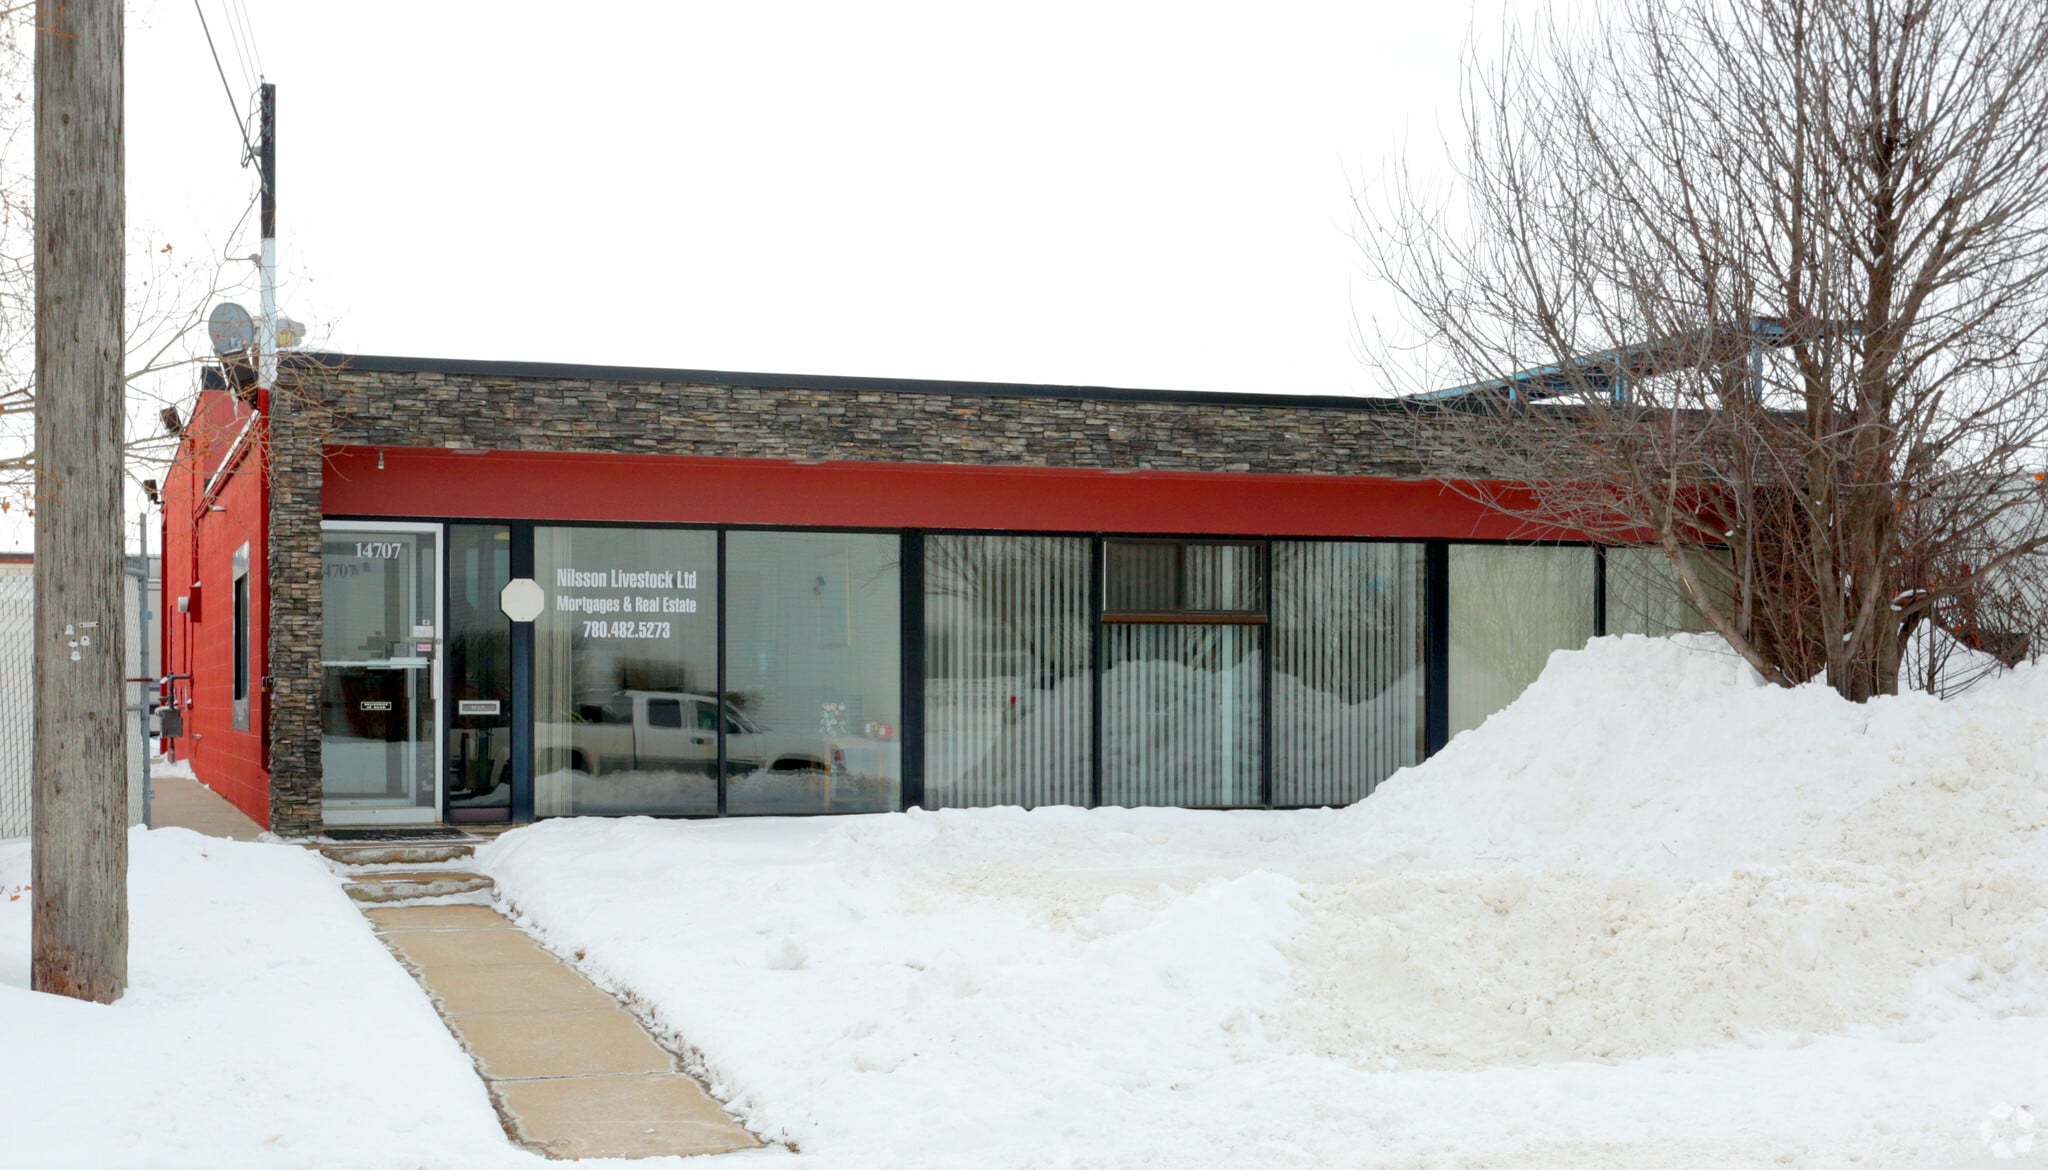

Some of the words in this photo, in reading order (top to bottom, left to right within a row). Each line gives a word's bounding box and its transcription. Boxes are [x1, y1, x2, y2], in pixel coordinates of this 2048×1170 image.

[355, 542, 401, 559] 14707
[556, 568, 607, 588] Nilsson
[611, 569, 673, 589] Livestock
[677, 570, 697, 589] Ltd
[556, 595, 620, 614] Mortgages
[623, 596, 632, 612] &
[635, 596, 659, 612] Real
[663, 597, 697, 613] Estate
[583, 621, 671, 639] 780.482.5273
